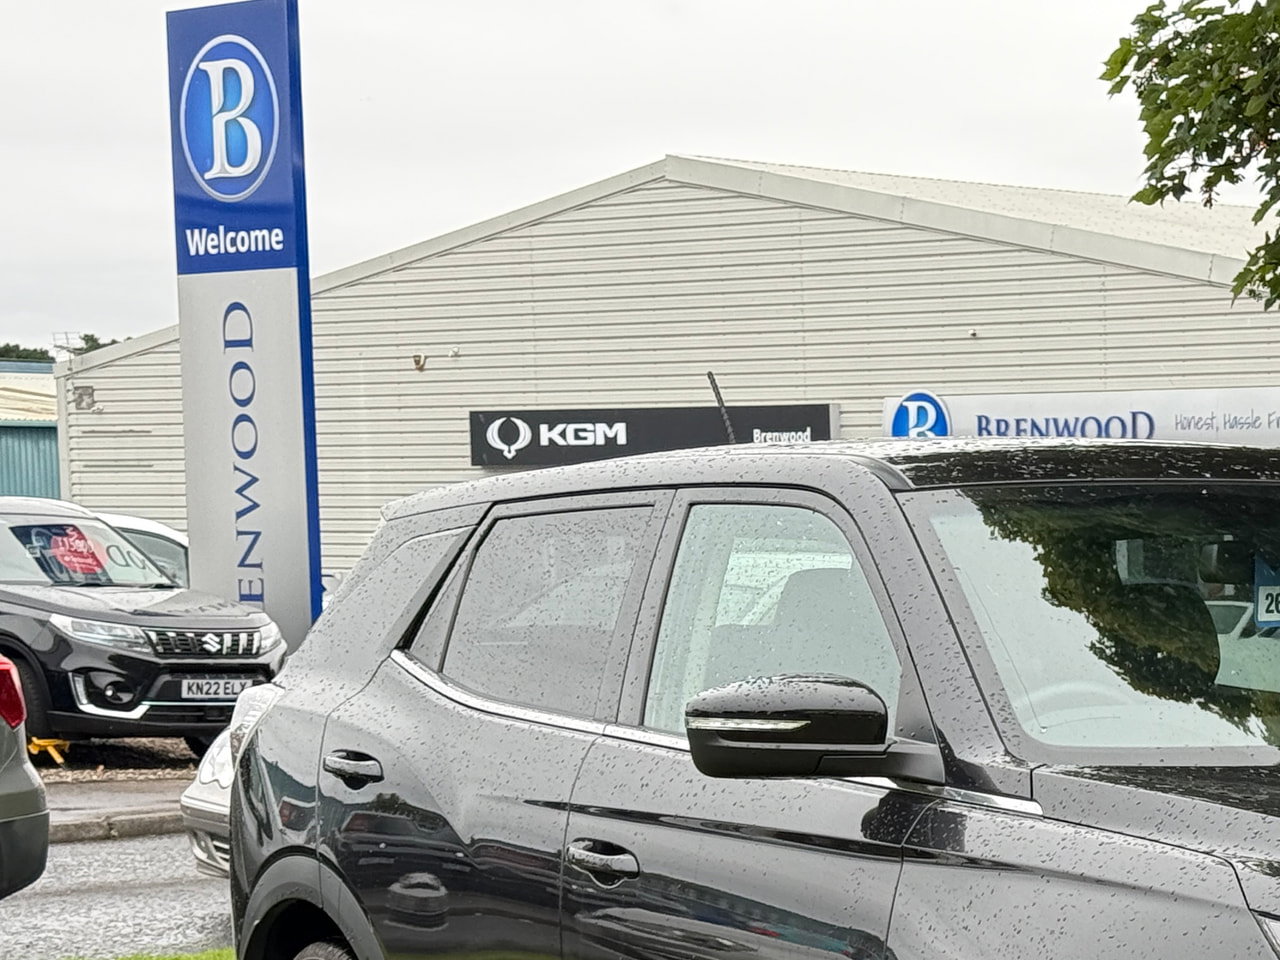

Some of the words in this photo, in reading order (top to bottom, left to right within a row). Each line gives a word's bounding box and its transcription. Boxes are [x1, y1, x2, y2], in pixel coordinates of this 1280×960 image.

[185, 225, 284, 256] Welcome
[976, 411, 1155, 439] BRENWOOD
[1175, 411, 1219, 432] Honest,
[1223, 408, 1262, 430] Hassle
[539, 422, 627, 447] KGM
[753, 427, 812, 443] Brenwood
[222, 301, 266, 612] ENWOOD
[186, 681, 220, 696] KN22
